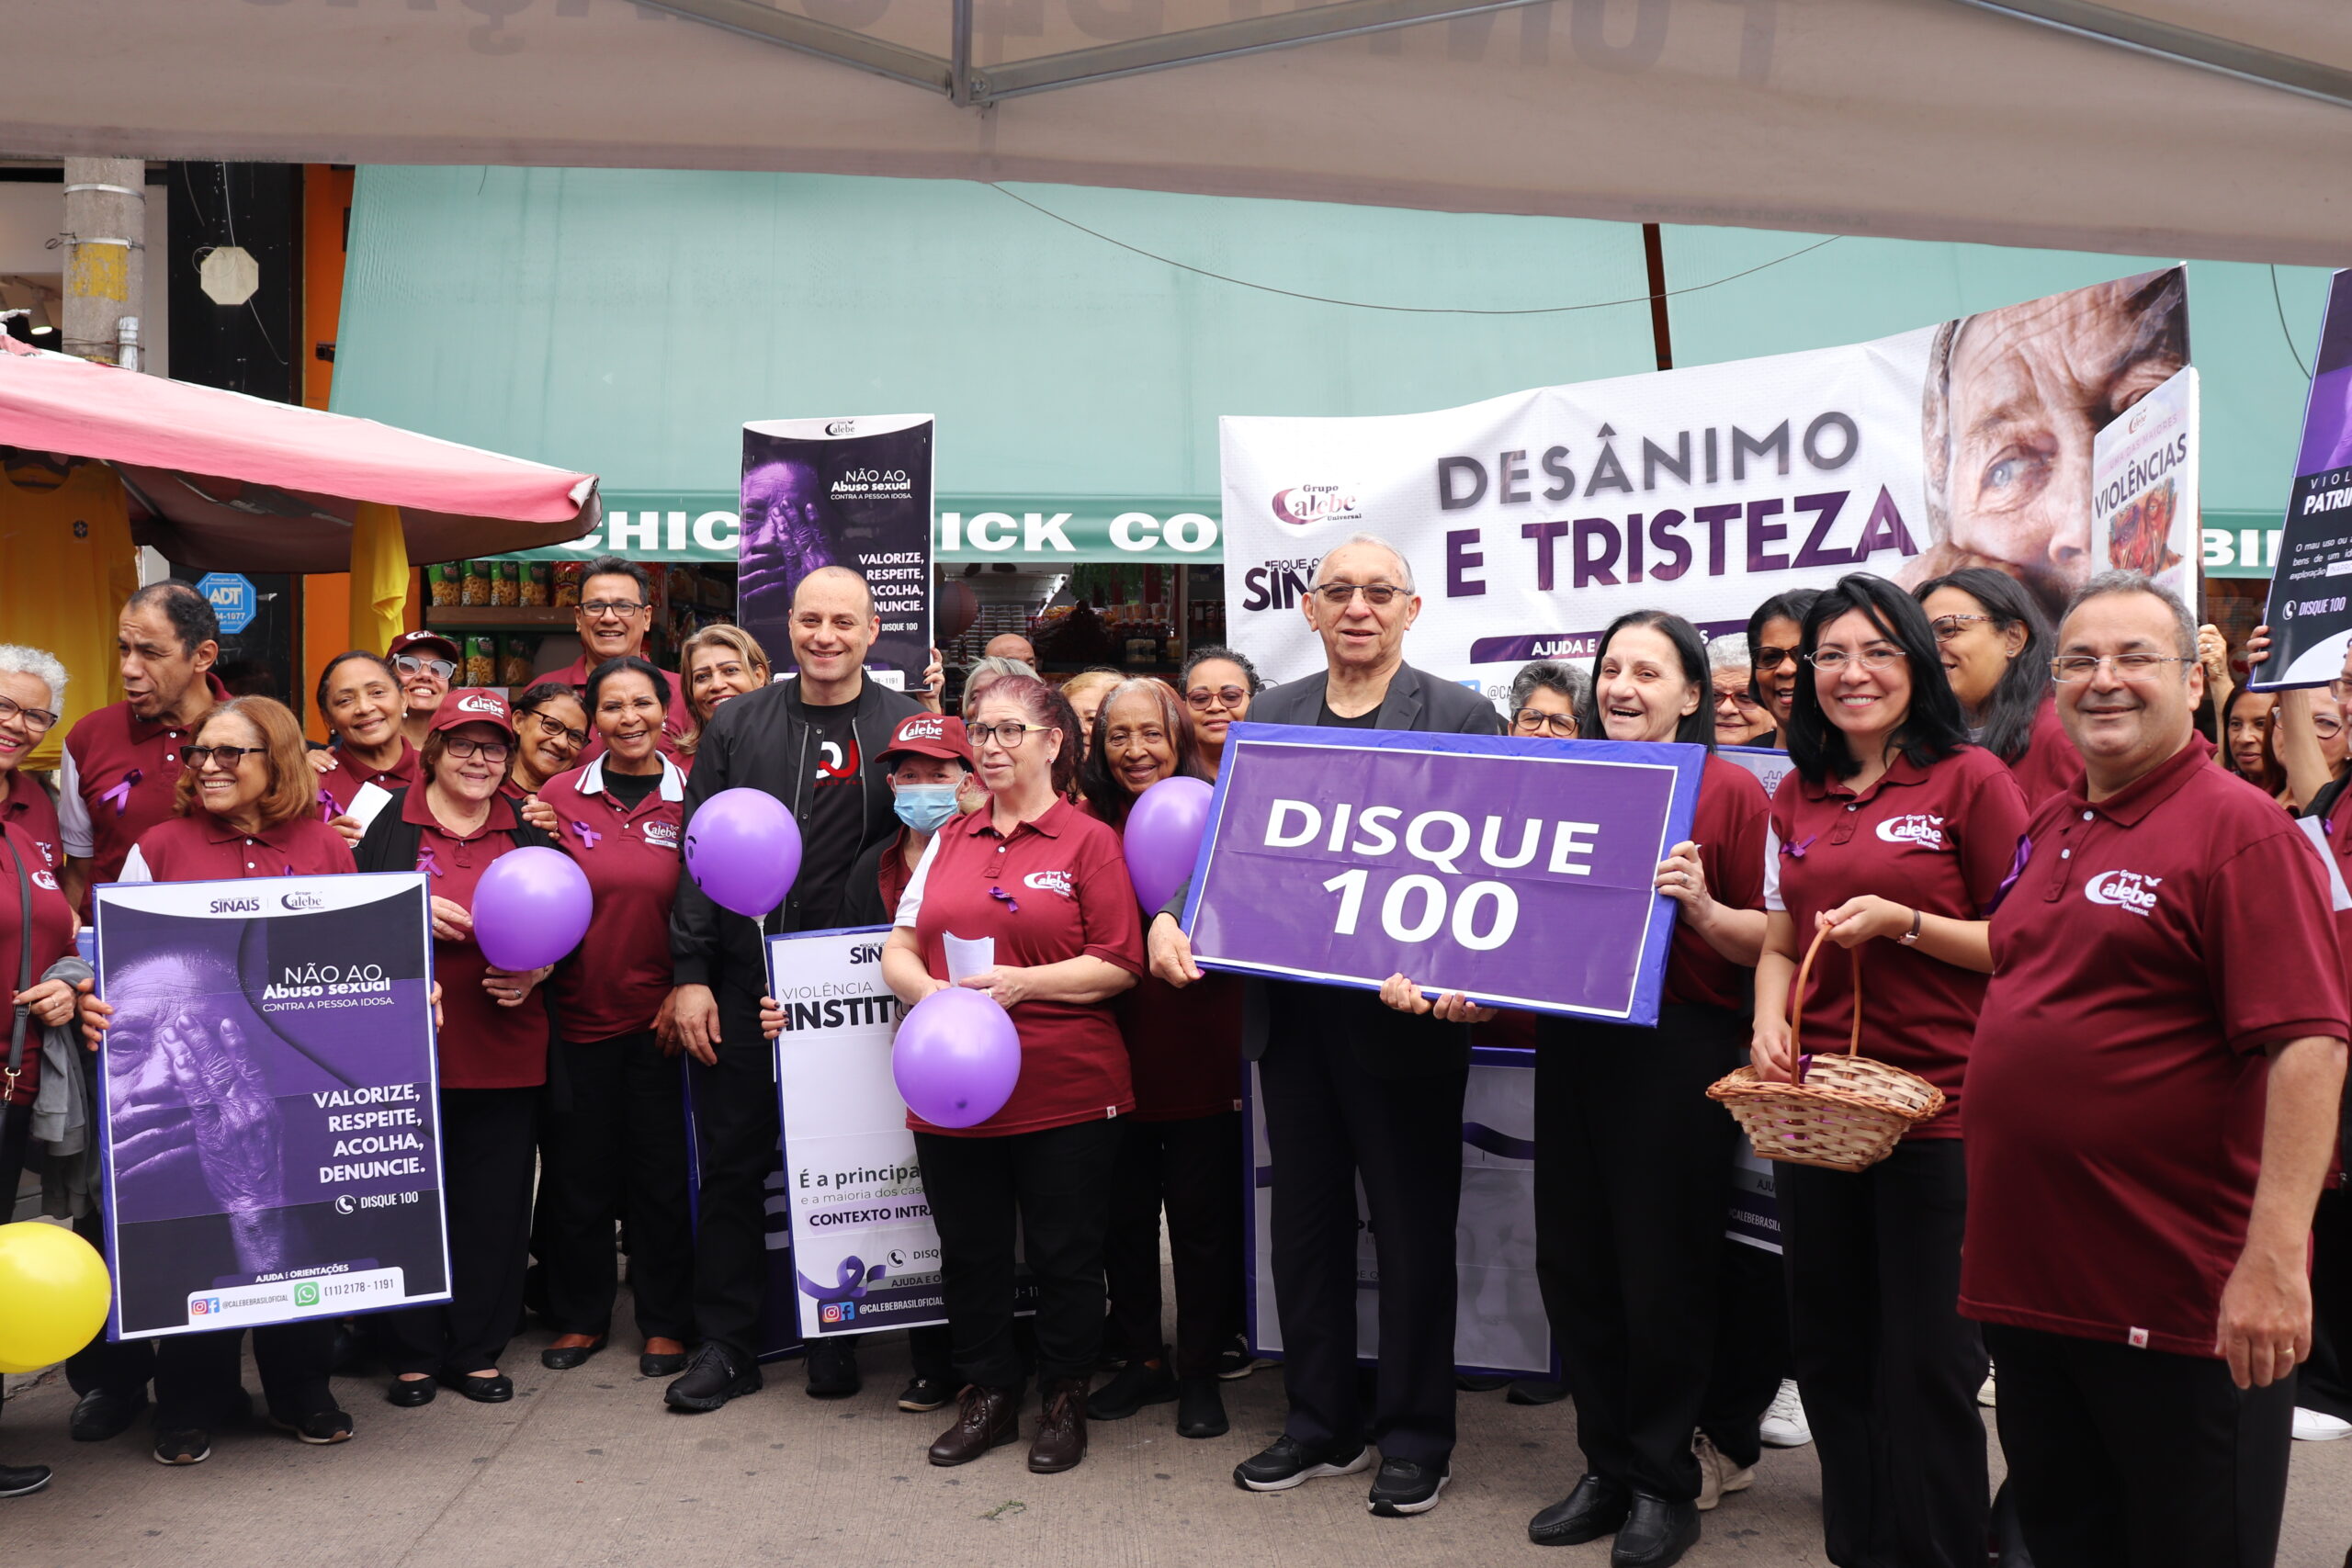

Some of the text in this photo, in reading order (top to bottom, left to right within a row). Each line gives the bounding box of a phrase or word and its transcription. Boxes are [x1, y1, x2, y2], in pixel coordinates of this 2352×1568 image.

[1437, 411, 1859, 511] DESÂNIMO
[845, 468, 906, 482] NÃO AO
[2095, 432, 2188, 520] VIOLÊNCIAS
[831, 479, 911, 492] Abuso sexual
[1303, 484, 1340, 493] Grupo
[1272, 487, 1357, 525] Calebe
[1327, 513, 1363, 522] Universal
[1445, 483, 1919, 599] E TRISTEZA
[2303, 539, 2321, 551] mau
[2322, 537, 2335, 548] uso
[2336, 536, 2348, 546] ou
[858, 552, 924, 565] VALORIZE,
[2291, 557, 2311, 567] bens
[2312, 553, 2324, 563] de
[2326, 551, 2340, 561] um
[866, 569, 924, 581] RESPEITE,
[2288, 568, 2327, 581] exploração
[209, 587, 243, 605] ADT
[2298, 596, 2347, 617] DISQUE 100
[881, 623, 918, 632] DISQUE 100
[1532, 637, 1596, 657] AJUDA E
[458, 694, 504, 715] Calebe
[899, 721, 944, 741] Calebe
[642, 821, 678, 839] Calebe
[1263, 798, 1600, 875] DISQUE
[1875, 816, 1942, 843] Calebe
[1023, 872, 1072, 892] Calebe
[2120, 869, 2143, 881] Grupo
[2085, 870, 2157, 908] Calebe
[209, 899, 260, 914] SINAIS
[281, 893, 322, 911] Calebe
[1321, 868, 1521, 952] 100
[285, 963, 382, 985] NÃO AO
[263, 977, 390, 999] Abuso sexual
[782, 982, 874, 1000] VIOLÊNCIA
[263, 997, 395, 1011] CONTRA A PESSOA IDOSA.
[312, 1083, 421, 1109] VALORIZE,
[328, 1108, 423, 1133] RESPEITE,
[333, 1133, 424, 1157] ACOLHA,
[319, 1156, 426, 1184] DENUNCIE.
[799, 1168, 810, 1189] É
[817, 1174, 828, 1187] a
[360, 1190, 419, 1209] DISQUE 100
[800, 1197, 808, 1205] e
[812, 1195, 820, 1204] a
[823, 1190, 871, 1203] maioria
[875, 1188, 898, 1199] dos
[809, 1208, 891, 1226] CONTEXTO
[254, 1275, 285, 1283] AJUDA
[290, 1264, 349, 1279] ORIENTAÇÕES
[891, 1278, 923, 1288] AJUDA
[925, 1276, 932, 1284] E
[222, 1294, 288, 1310] @CALEBEBRASILOFICIAL
[324, 1286, 342, 1297] (11)
[344, 1282, 366, 1295] 2178
[374, 1279, 394, 1291] 1191
[859, 1296, 944, 1314] @CALEBEBRASILOFICIAL
